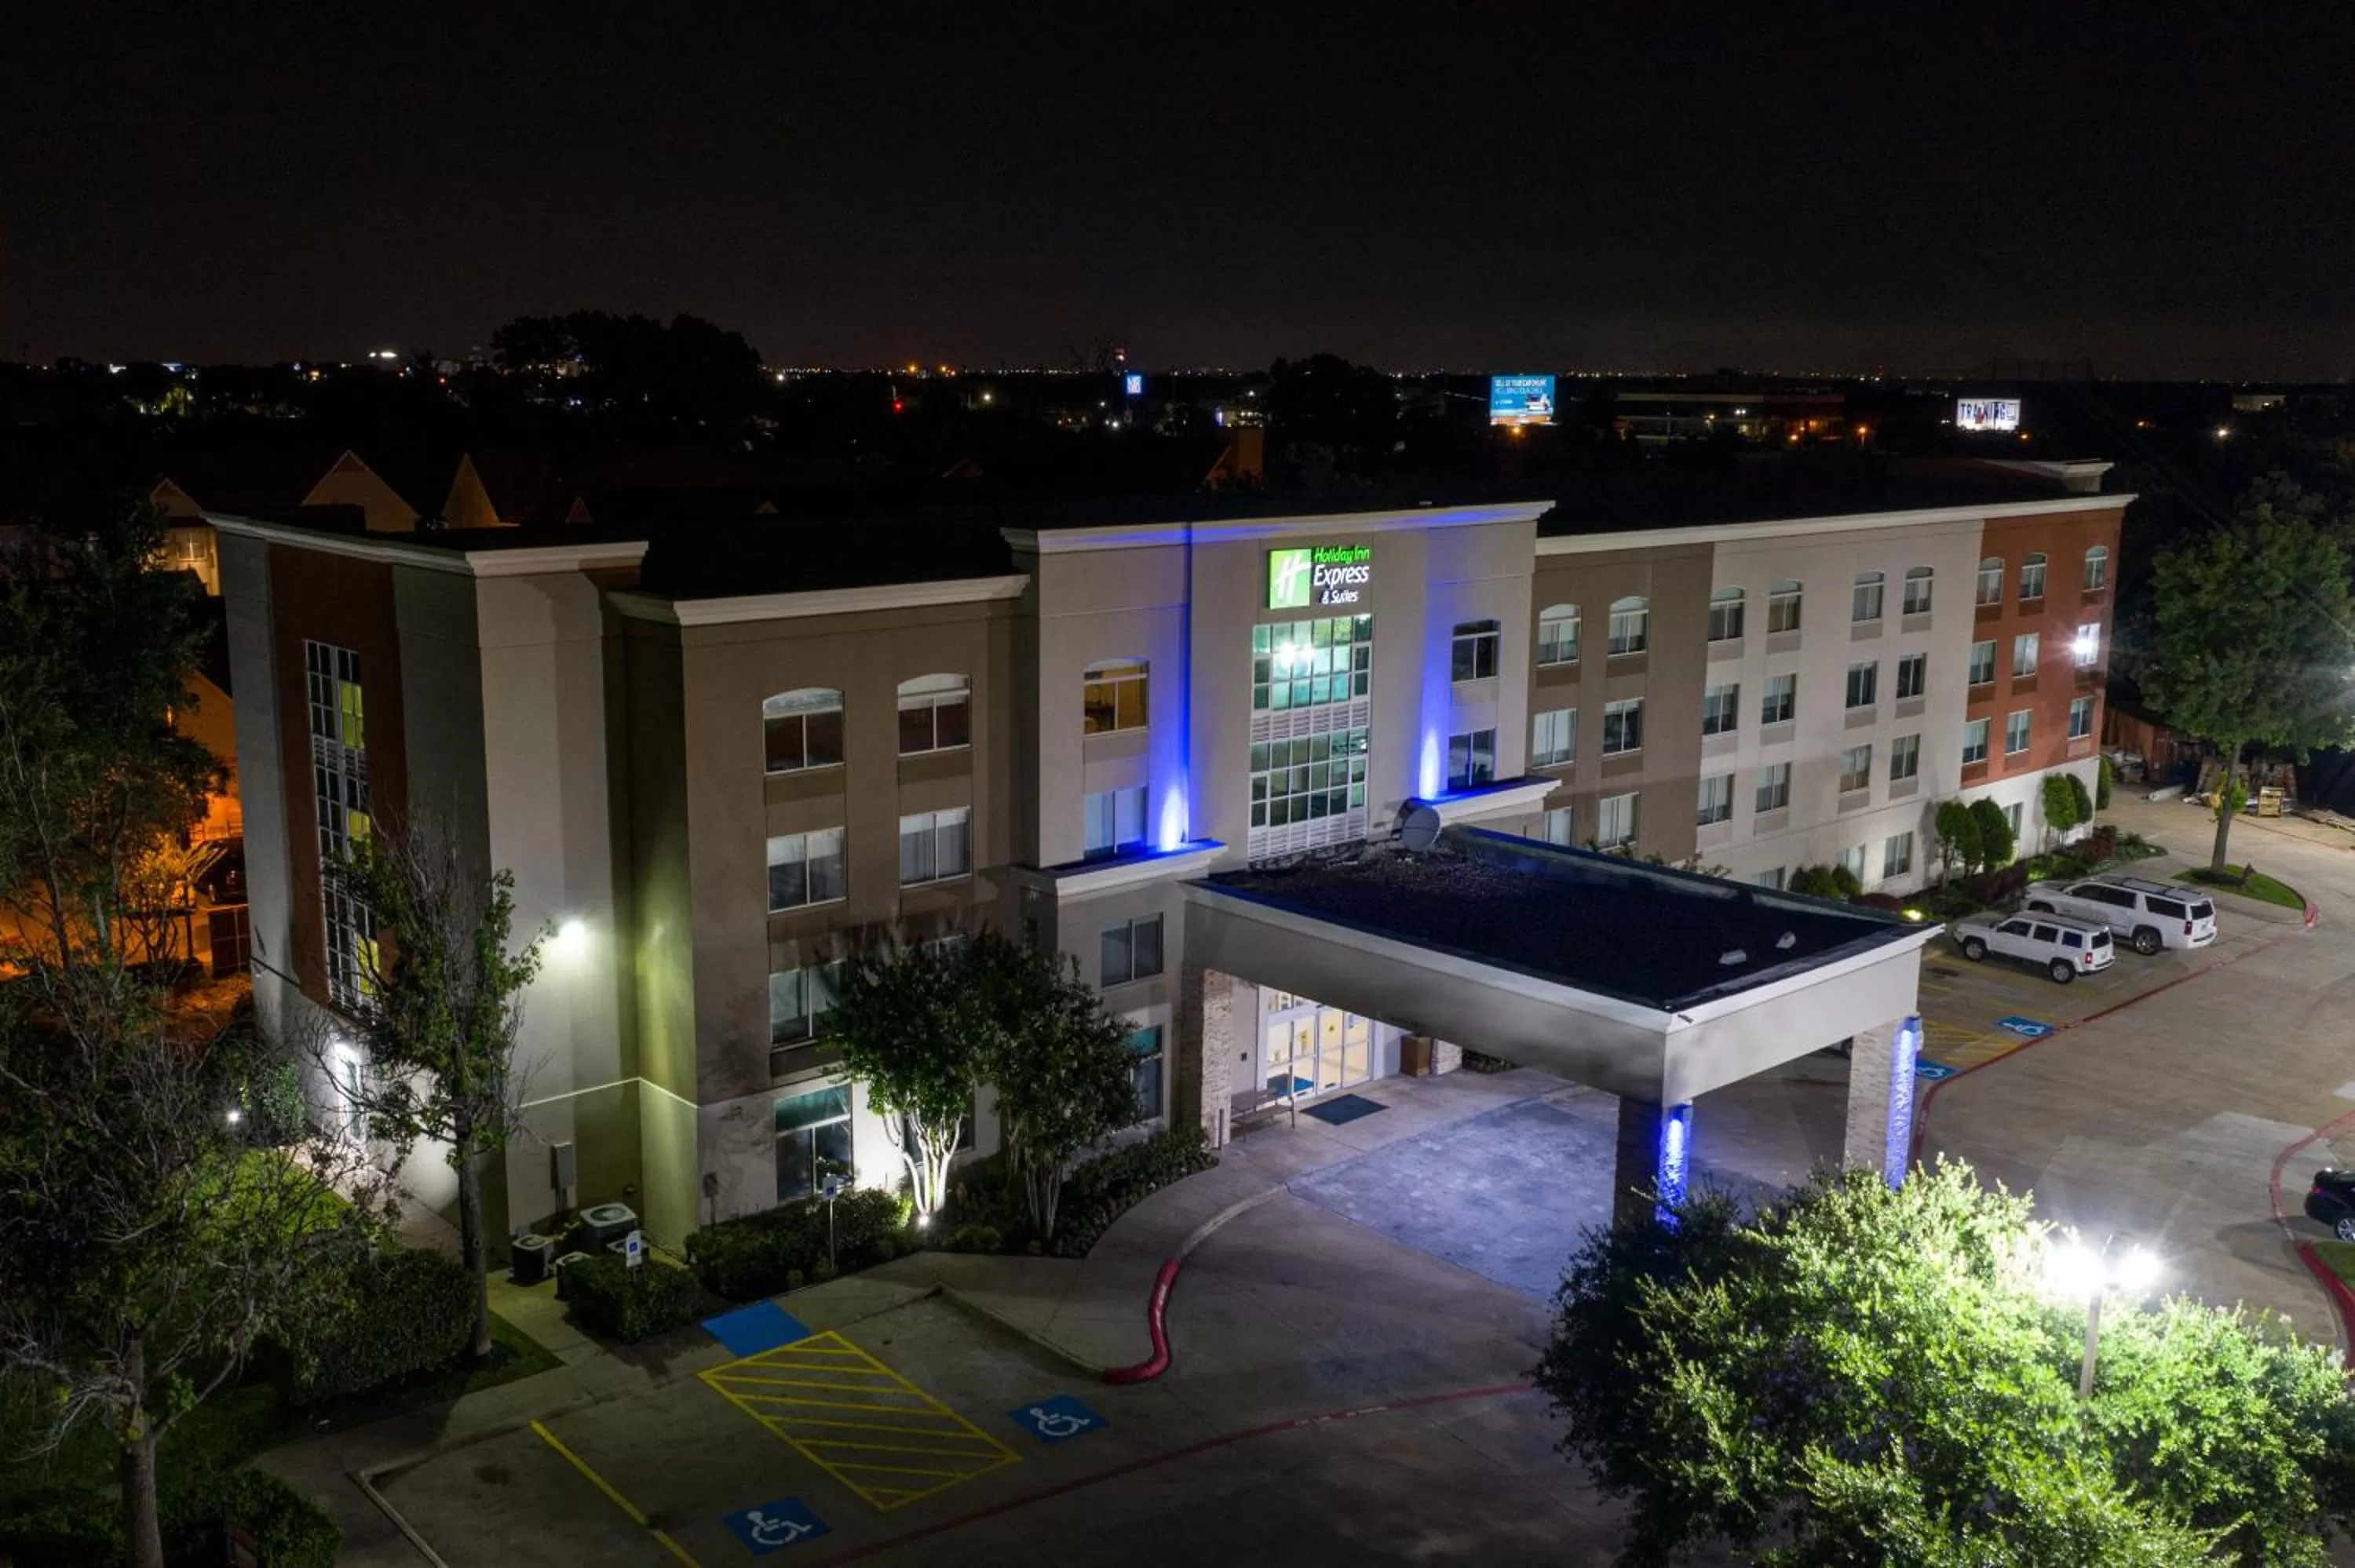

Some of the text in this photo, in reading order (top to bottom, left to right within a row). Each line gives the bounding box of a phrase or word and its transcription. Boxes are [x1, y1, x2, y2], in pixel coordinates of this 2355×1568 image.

[1314, 545, 1370, 563] Holiday Inn
[1313, 564, 1370, 589] Express
[1321, 590, 1359, 604] & Suites
